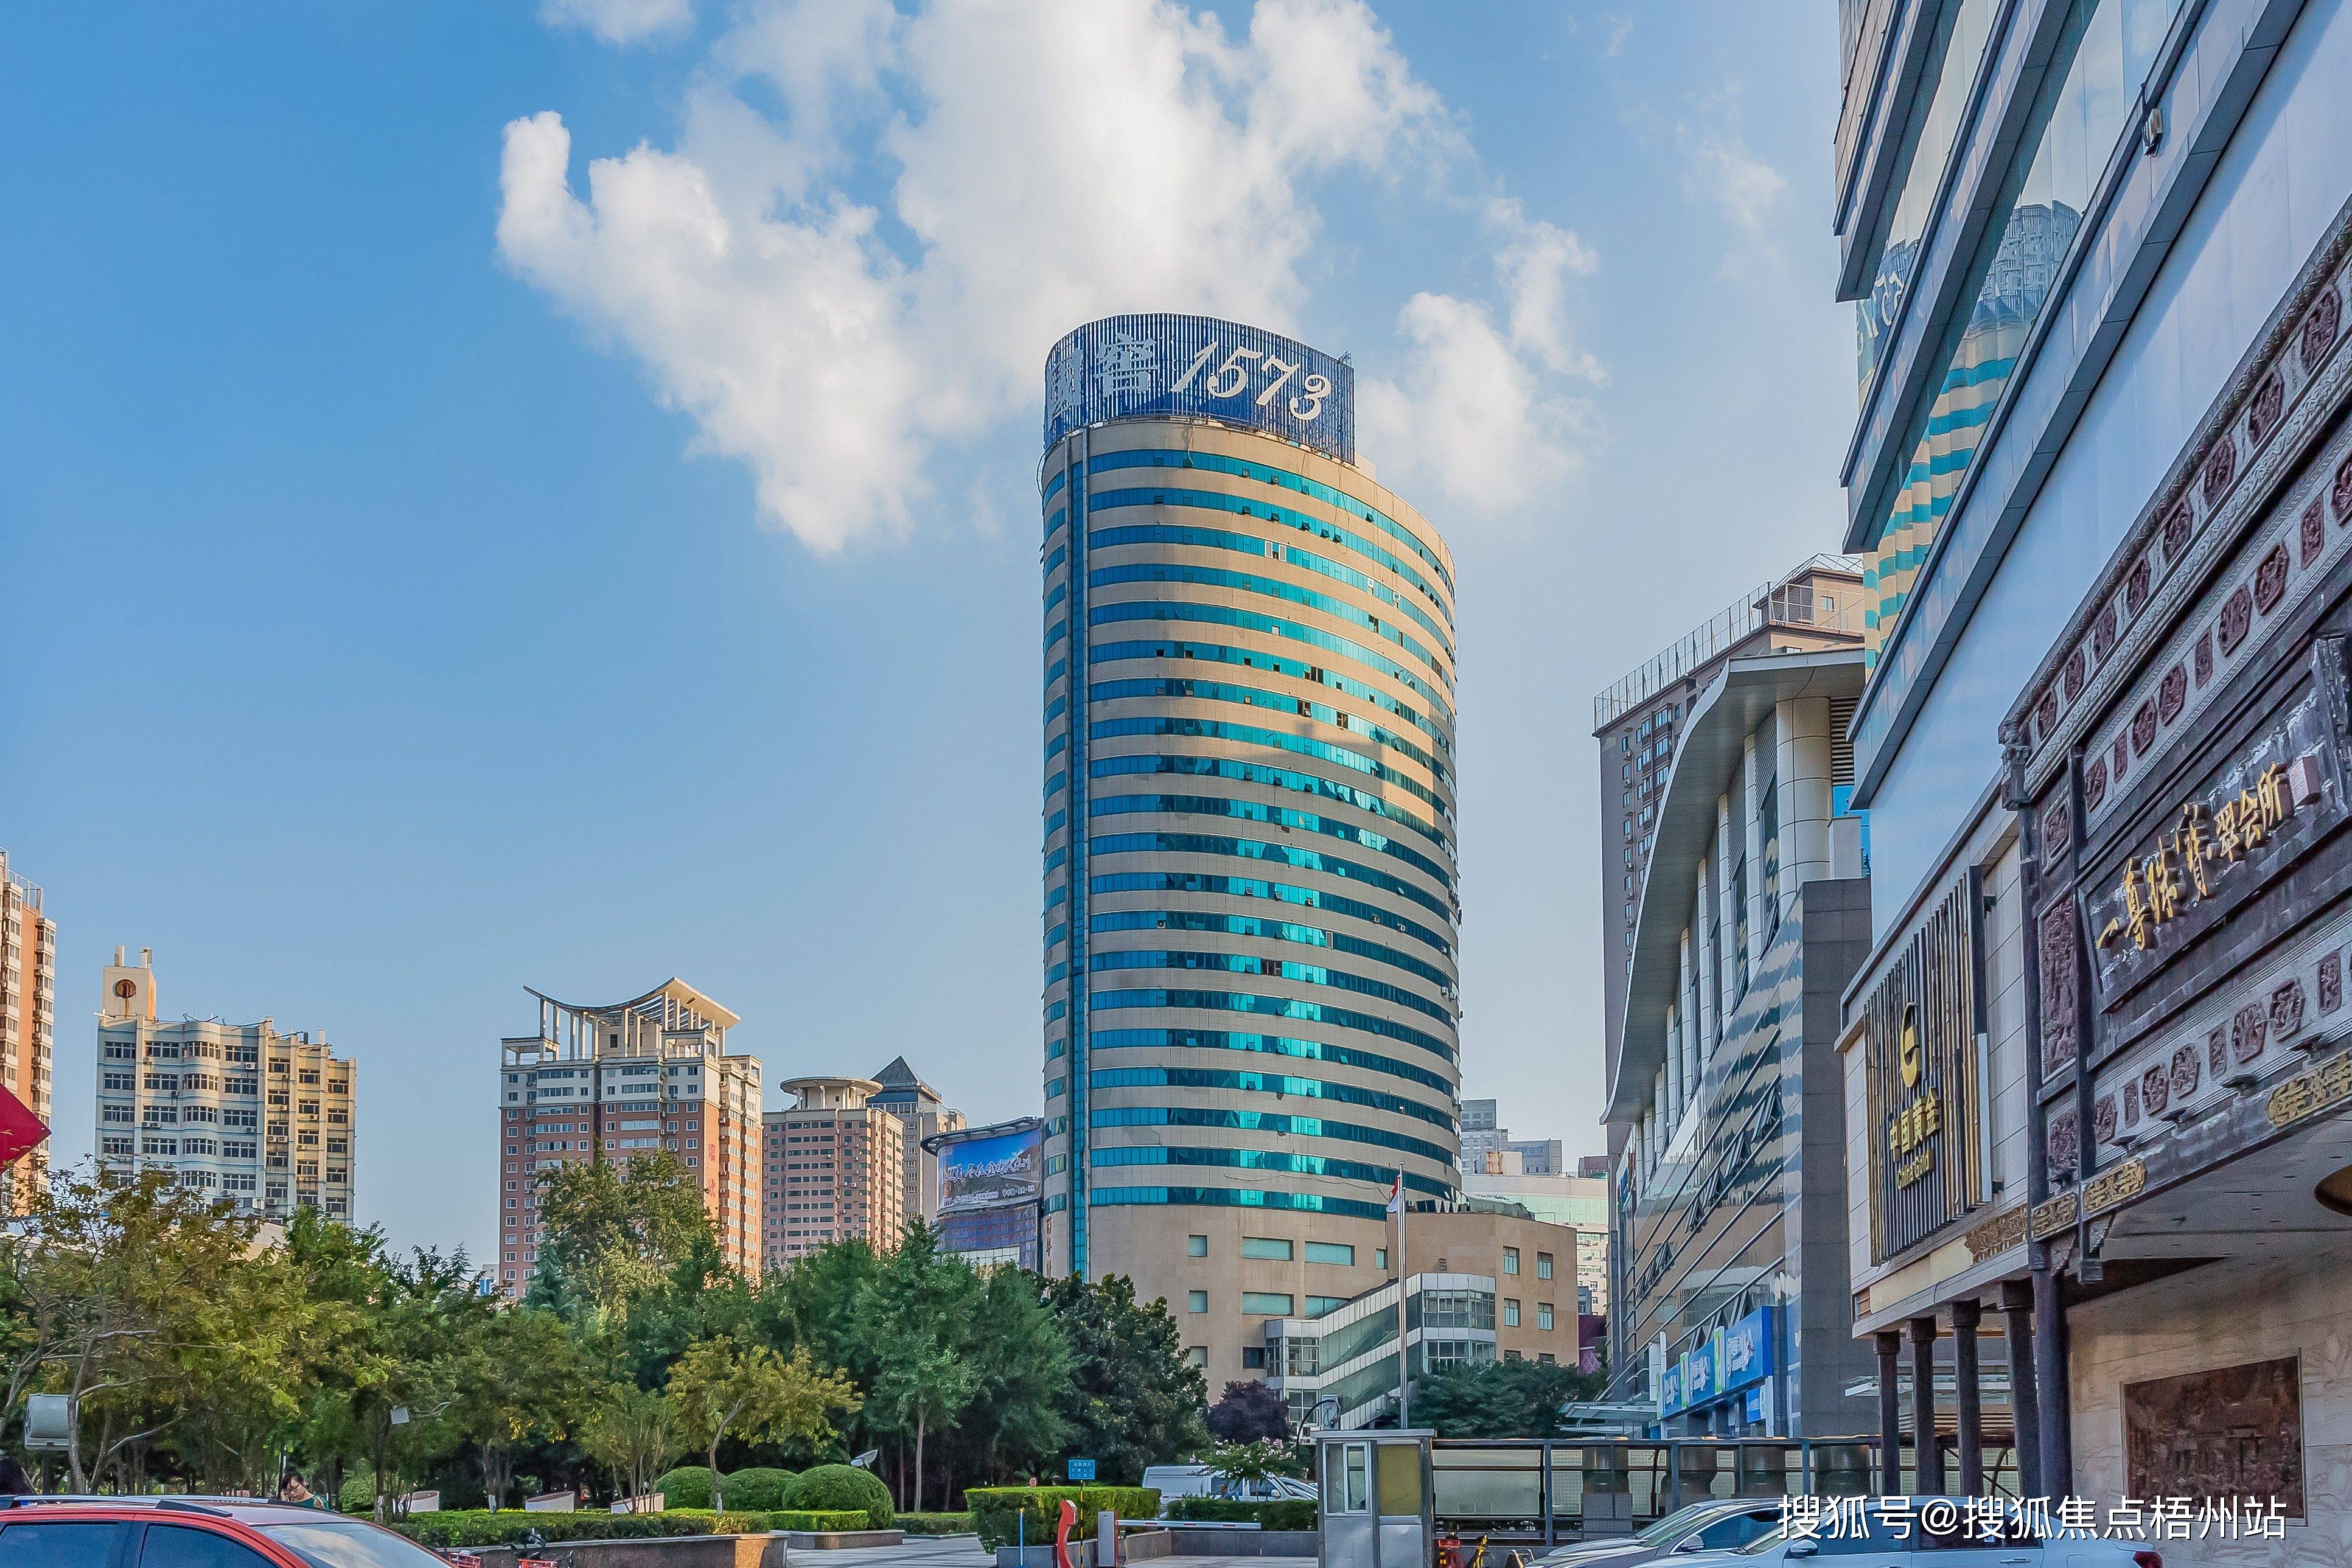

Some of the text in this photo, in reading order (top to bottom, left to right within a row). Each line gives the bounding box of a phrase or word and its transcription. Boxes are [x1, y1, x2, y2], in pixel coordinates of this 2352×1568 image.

[1890, 1087, 1939, 1162] 中国黄金
[1897, 1150, 1930, 1190] China Gold
